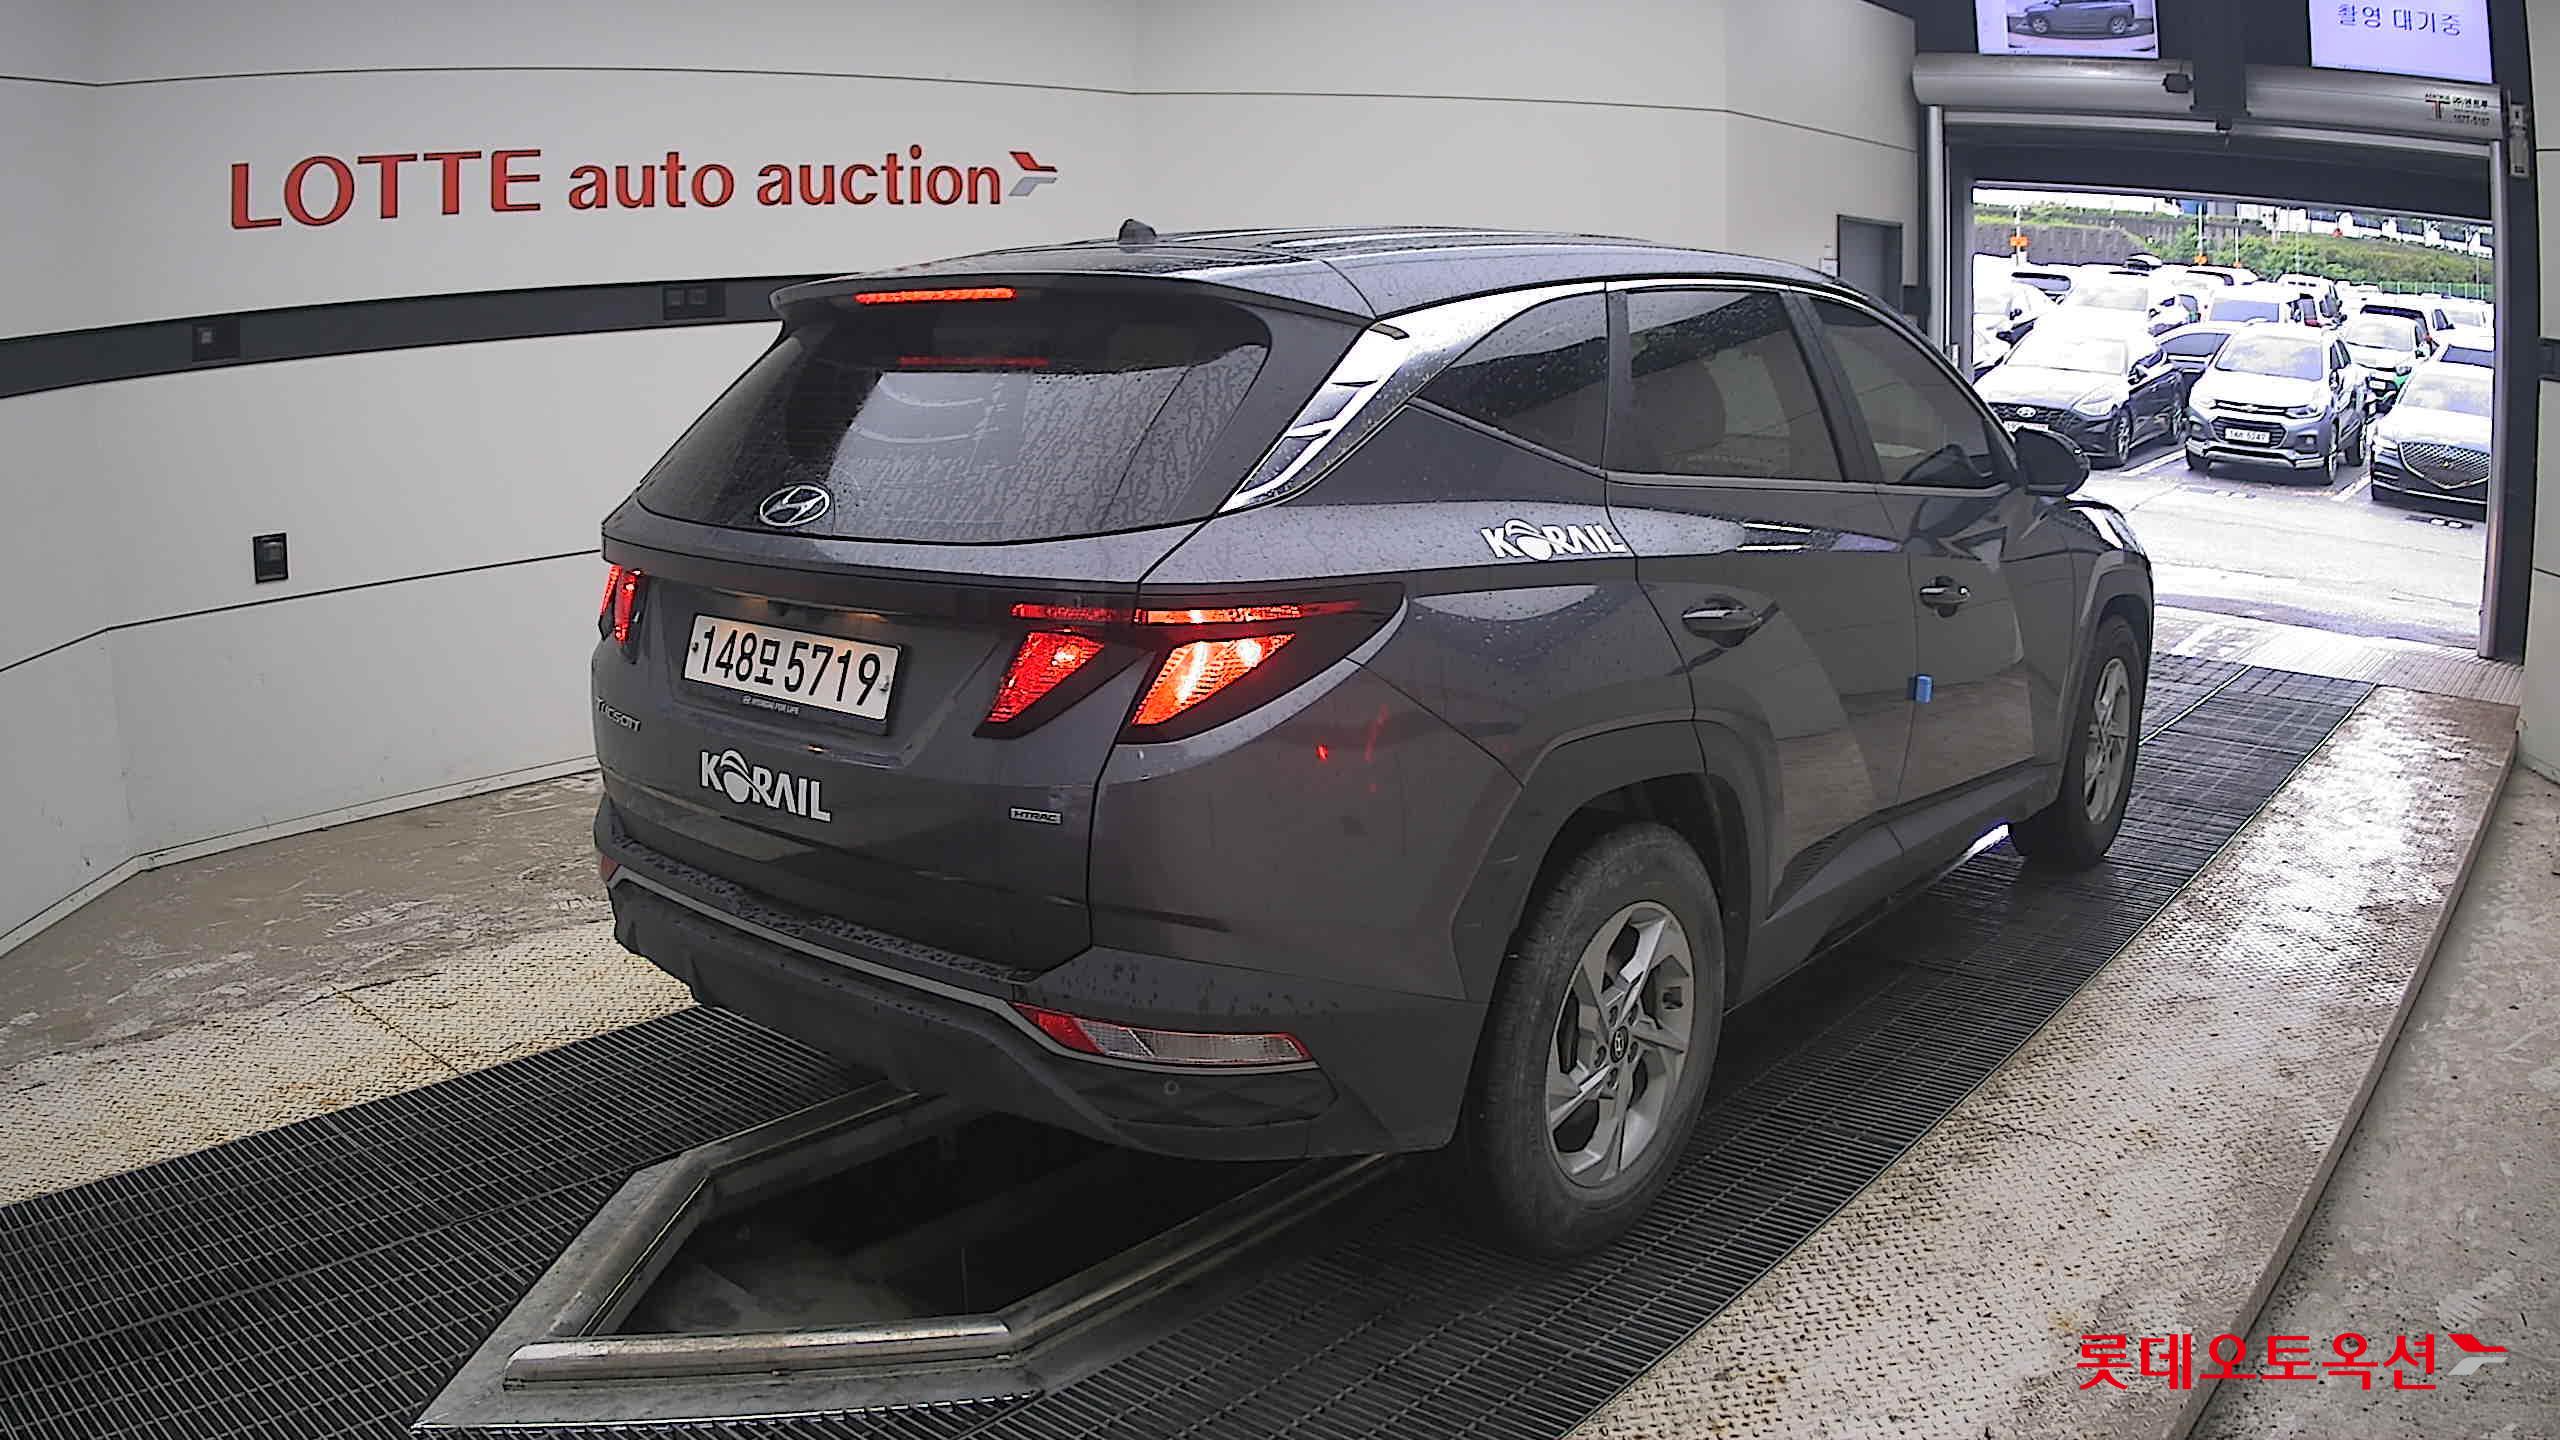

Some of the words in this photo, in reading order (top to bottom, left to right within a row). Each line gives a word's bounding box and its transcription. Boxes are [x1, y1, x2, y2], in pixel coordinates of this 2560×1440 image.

[2392, 9, 2461, 37] 대기중
[231, 149, 541, 230] LOTTE
[568, 151, 735, 210] auto
[757, 144, 1001, 206] auction
[1480, 518, 1628, 562] KORAIL
[701, 749, 832, 822] KORAIL
